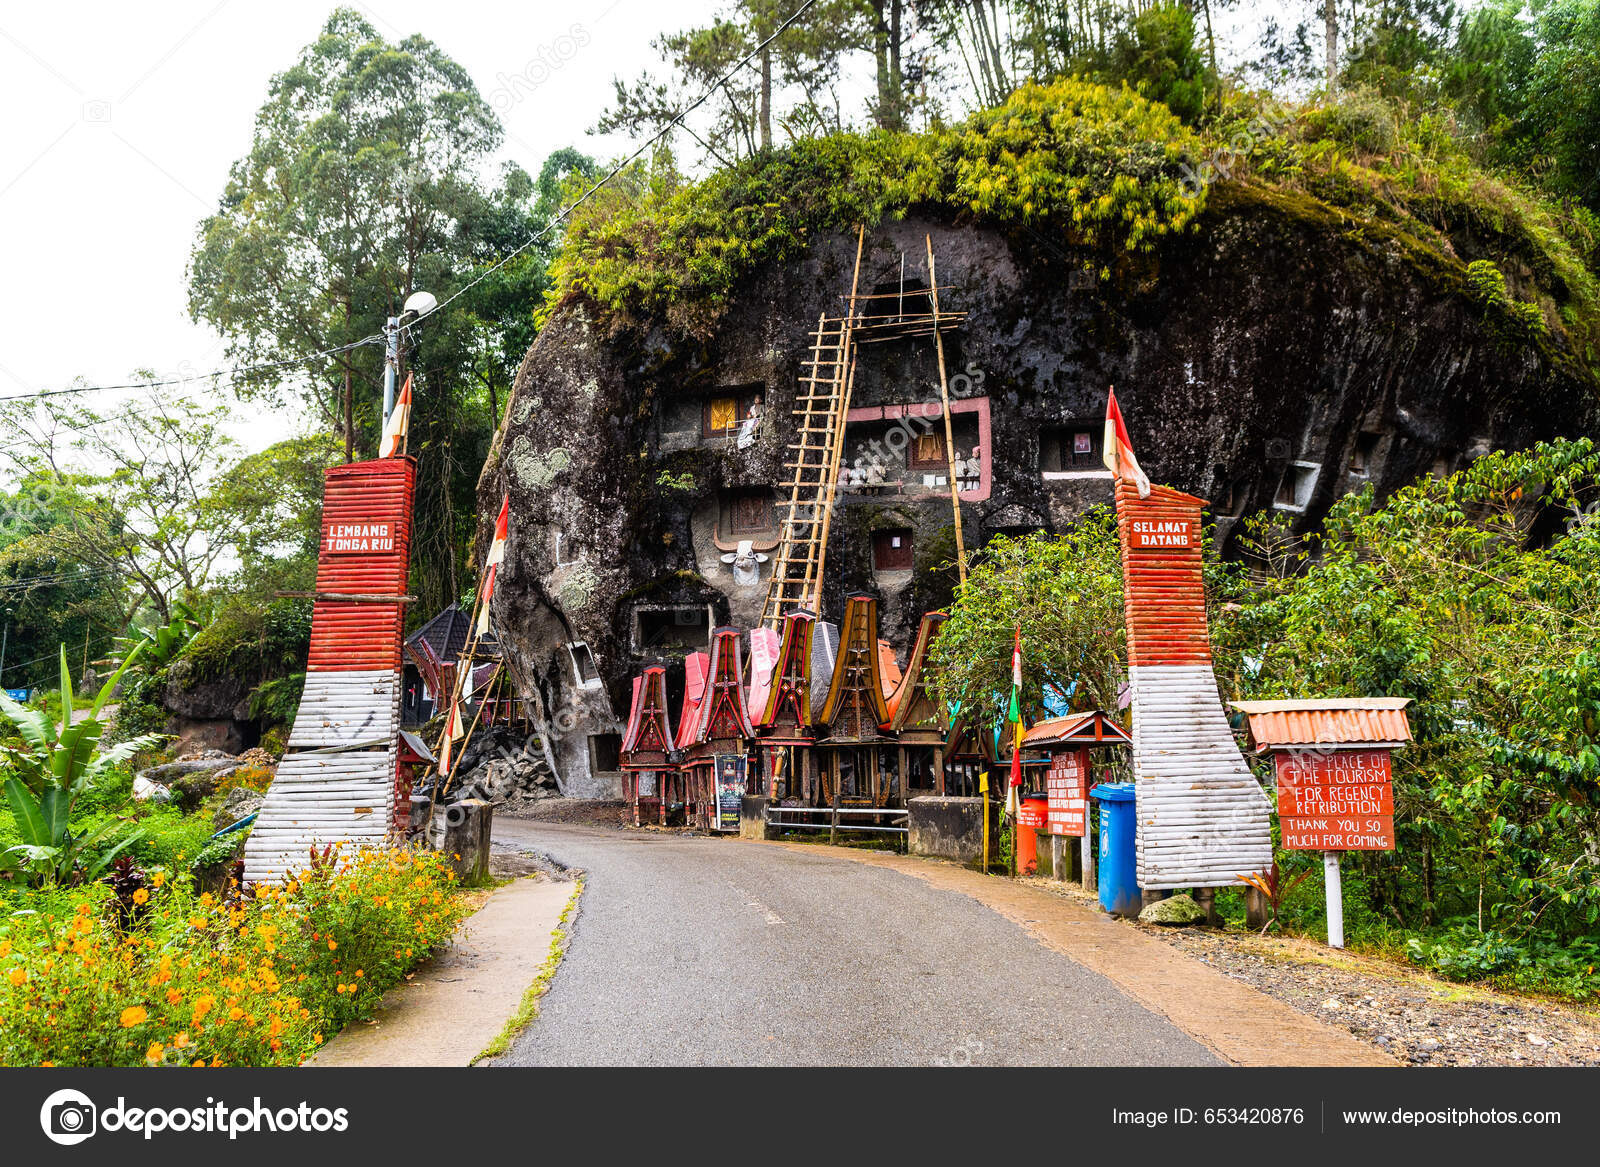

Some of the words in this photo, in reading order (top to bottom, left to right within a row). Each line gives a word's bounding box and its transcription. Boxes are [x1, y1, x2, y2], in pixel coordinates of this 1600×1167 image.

[329, 525, 388, 537] LEMBANG
[1133, 521, 1188, 533] SELAMAT
[1141, 534, 1188, 546] DATANG
[1288, 755, 1319, 770] THE
[1327, 755, 1365, 770] PLACE
[1370, 754, 1388, 769] OF
[1289, 770, 1320, 785] THE
[1325, 769, 1387, 784] TOURISM
[1295, 786, 1322, 802] FOR
[1329, 785, 1385, 802] REGENCY
[1296, 800, 1381, 815] RETRIBUTION
[1287, 819, 1328, 831] THANK
[1337, 819, 1360, 832] YOU
[1366, 820, 1381, 833] SO
[1286, 835, 1319, 847] MUCH
[1323, 834, 1346, 847] FOR
[1346, 834, 1388, 848] COMING
